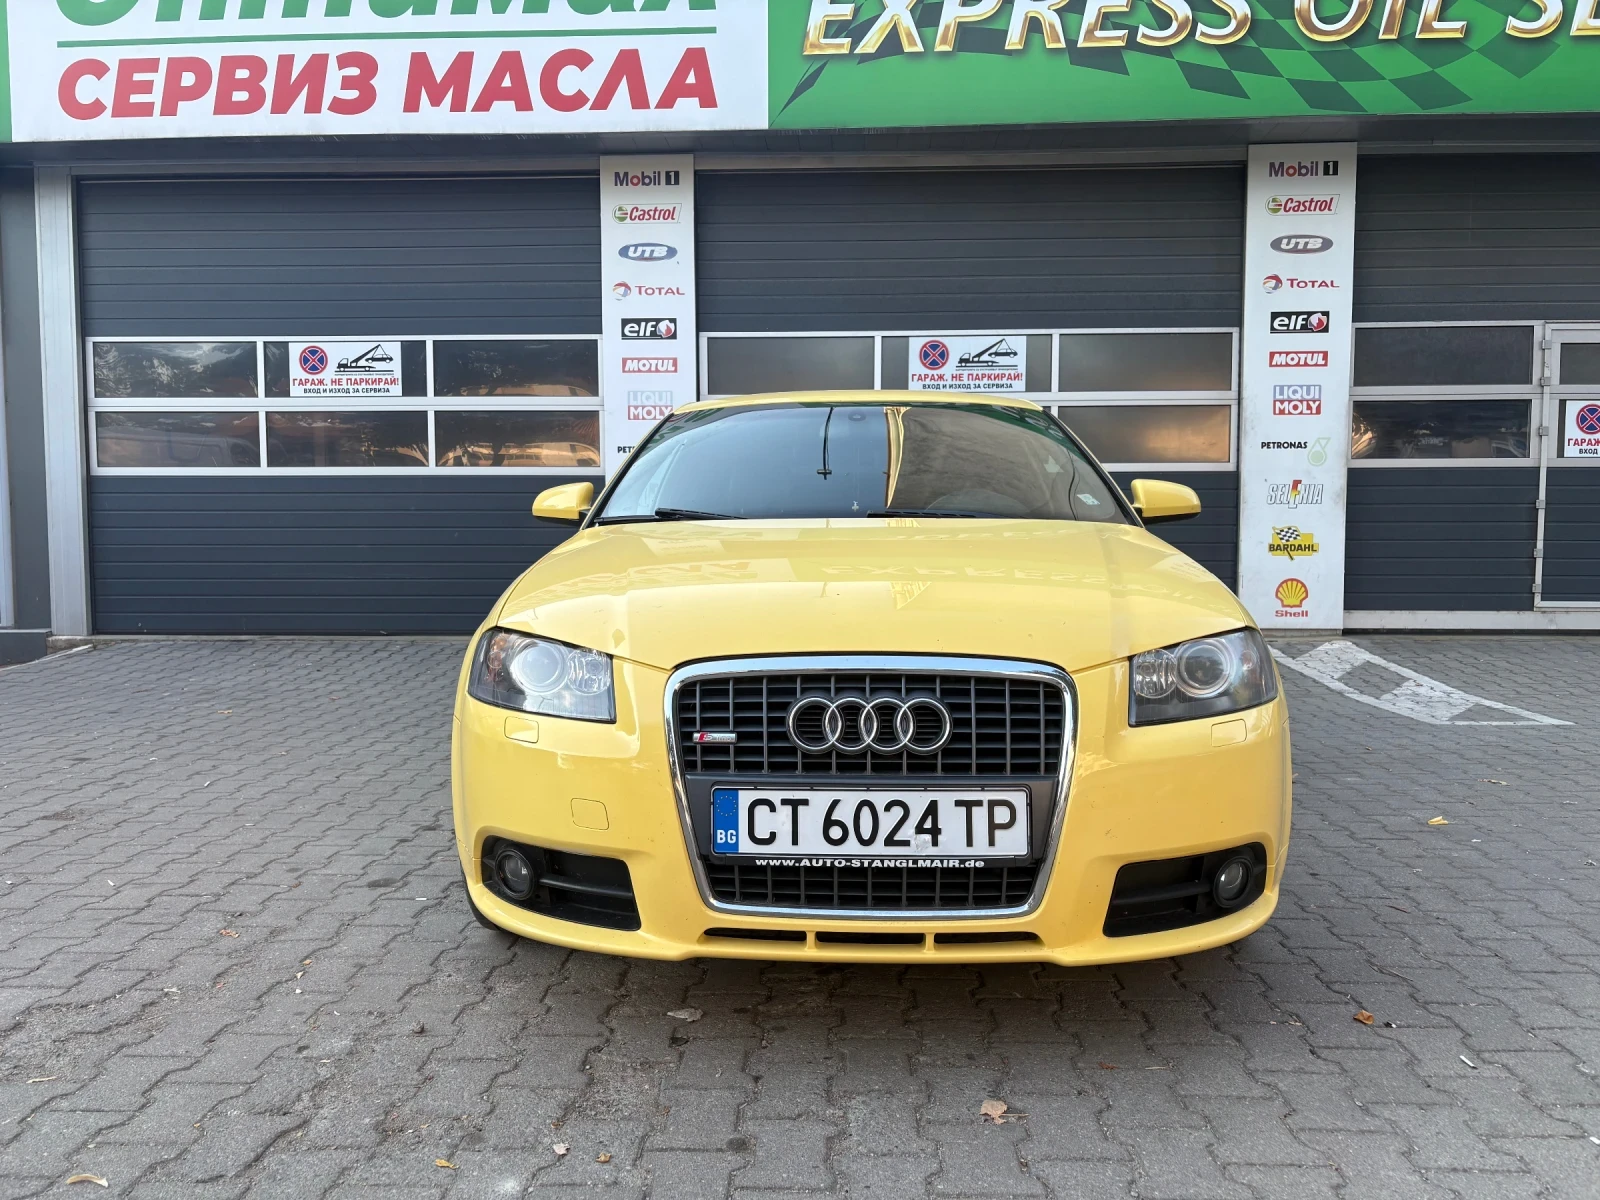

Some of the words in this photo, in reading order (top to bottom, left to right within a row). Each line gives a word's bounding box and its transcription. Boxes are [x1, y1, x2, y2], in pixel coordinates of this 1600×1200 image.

[57, 51, 379, 120] СЕРВИЗ
[402, 47, 718, 114] МАСЛА
[1268, 161, 1319, 178] Mobil
[1327, 161, 1334, 175] 1
[614, 171, 661, 187] Mobil
[668, 171, 676, 185] 1
[1283, 197, 1334, 213] Castrol
[629, 206, 677, 221] Castrol
[1280, 238, 1323, 250] UTB
[627, 246, 668, 258] UTB
[623, 321, 656, 337] elf
[1272, 314, 1307, 330] elf
[624, 359, 676, 371] MOTUL
[1271, 353, 1326, 366] MOTUL
[292, 378, 328, 387] ГАРАЖ.
[330, 377, 343, 386] НЕ
[346, 375, 399, 386] ПАРКИРАЙ!
[911, 373, 948, 382] ГАРАЖ.
[951, 373, 964, 382] НЕ
[967, 371, 1023, 381] ПАРКИРАЙ!
[629, 391, 672, 404] LIQUI
[1275, 386, 1320, 400] LIQUI
[629, 406, 673, 419] MOLY
[1275, 401, 1320, 415] MOLY
[1267, 479, 1324, 509] SELENIA
[1269, 544, 1317, 552] BARDAHL
[1275, 610, 1308, 618] Shell
[747, 798, 809, 846] CT
[822, 799, 942, 847] 6024
[954, 799, 1017, 847] TP
[716, 829, 736, 844] BG
[755, 857, 985, 869] www.AUTO-STANGLMAIR.de
